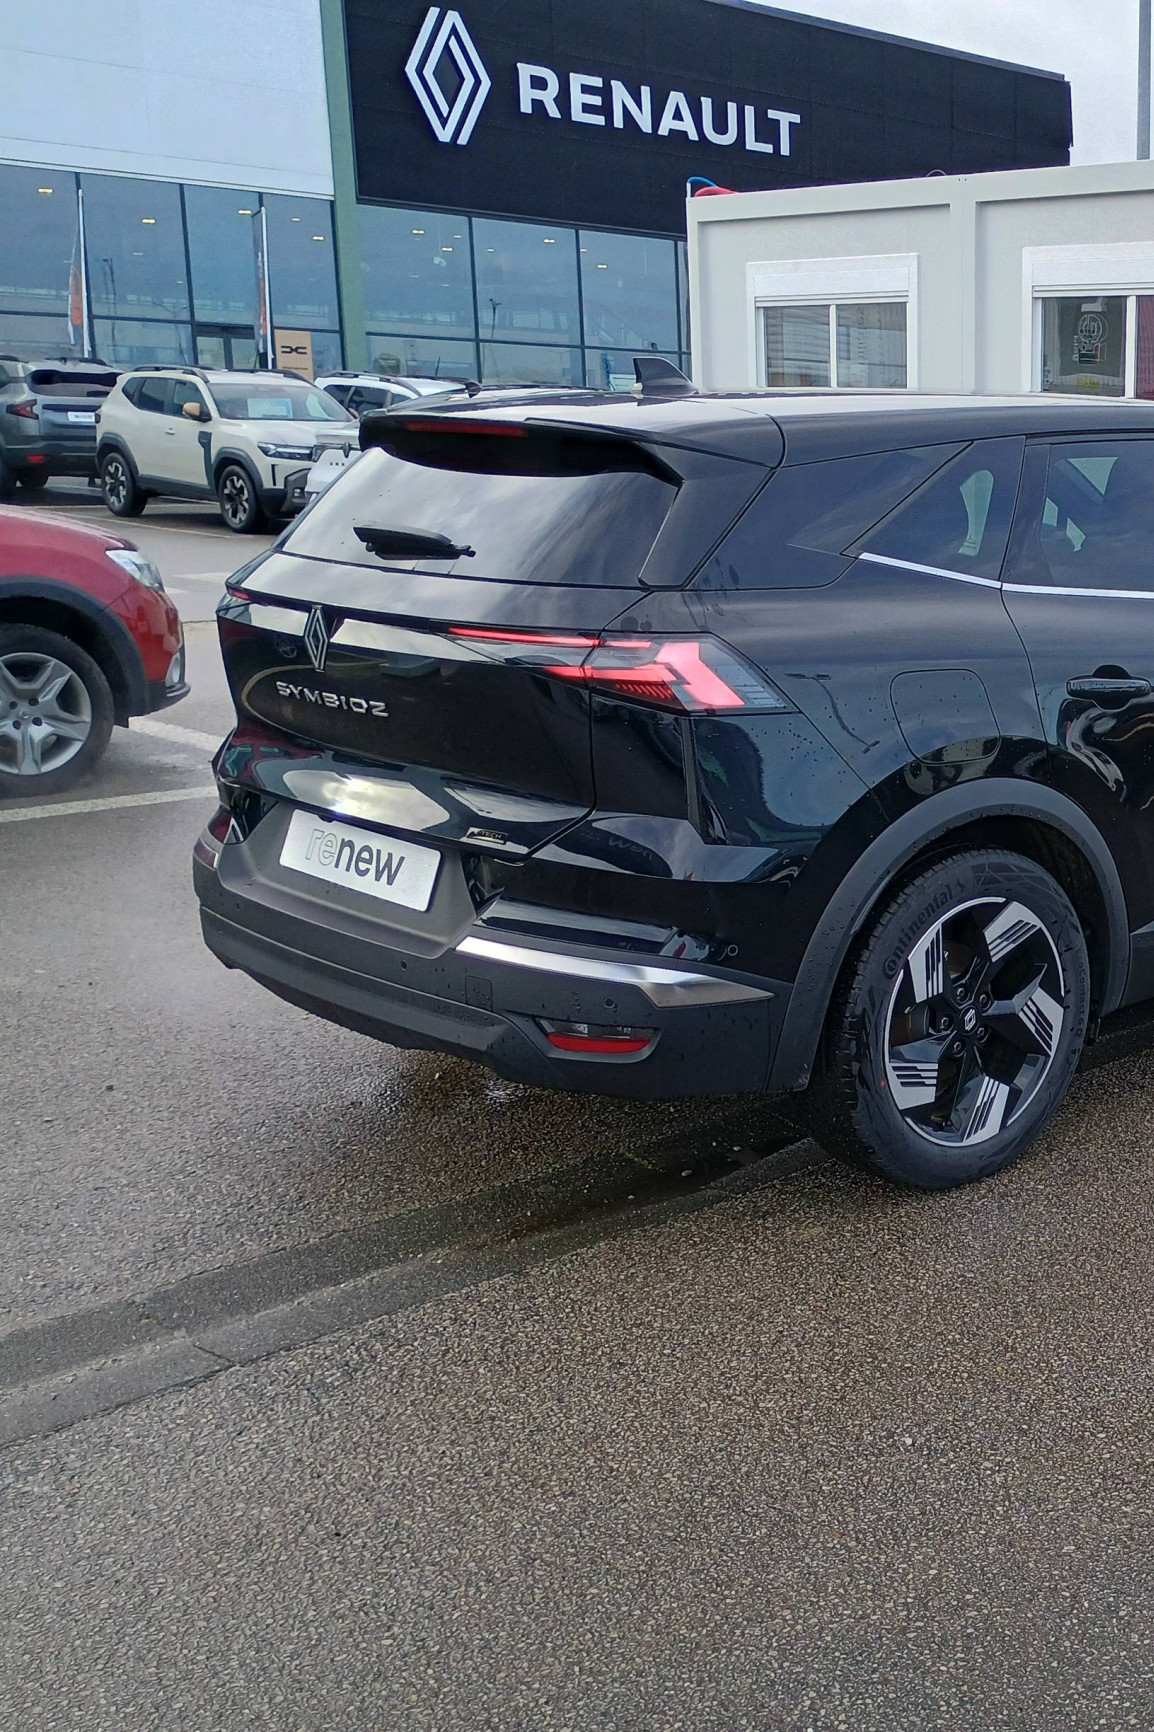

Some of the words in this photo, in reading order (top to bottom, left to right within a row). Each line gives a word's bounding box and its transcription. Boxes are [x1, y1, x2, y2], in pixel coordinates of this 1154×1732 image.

[516, 62, 801, 157] RENAULT
[275, 681, 390, 718] SYMBIOZ
[304, 828, 406, 886] renew
[882, 884, 954, 982] Continental
